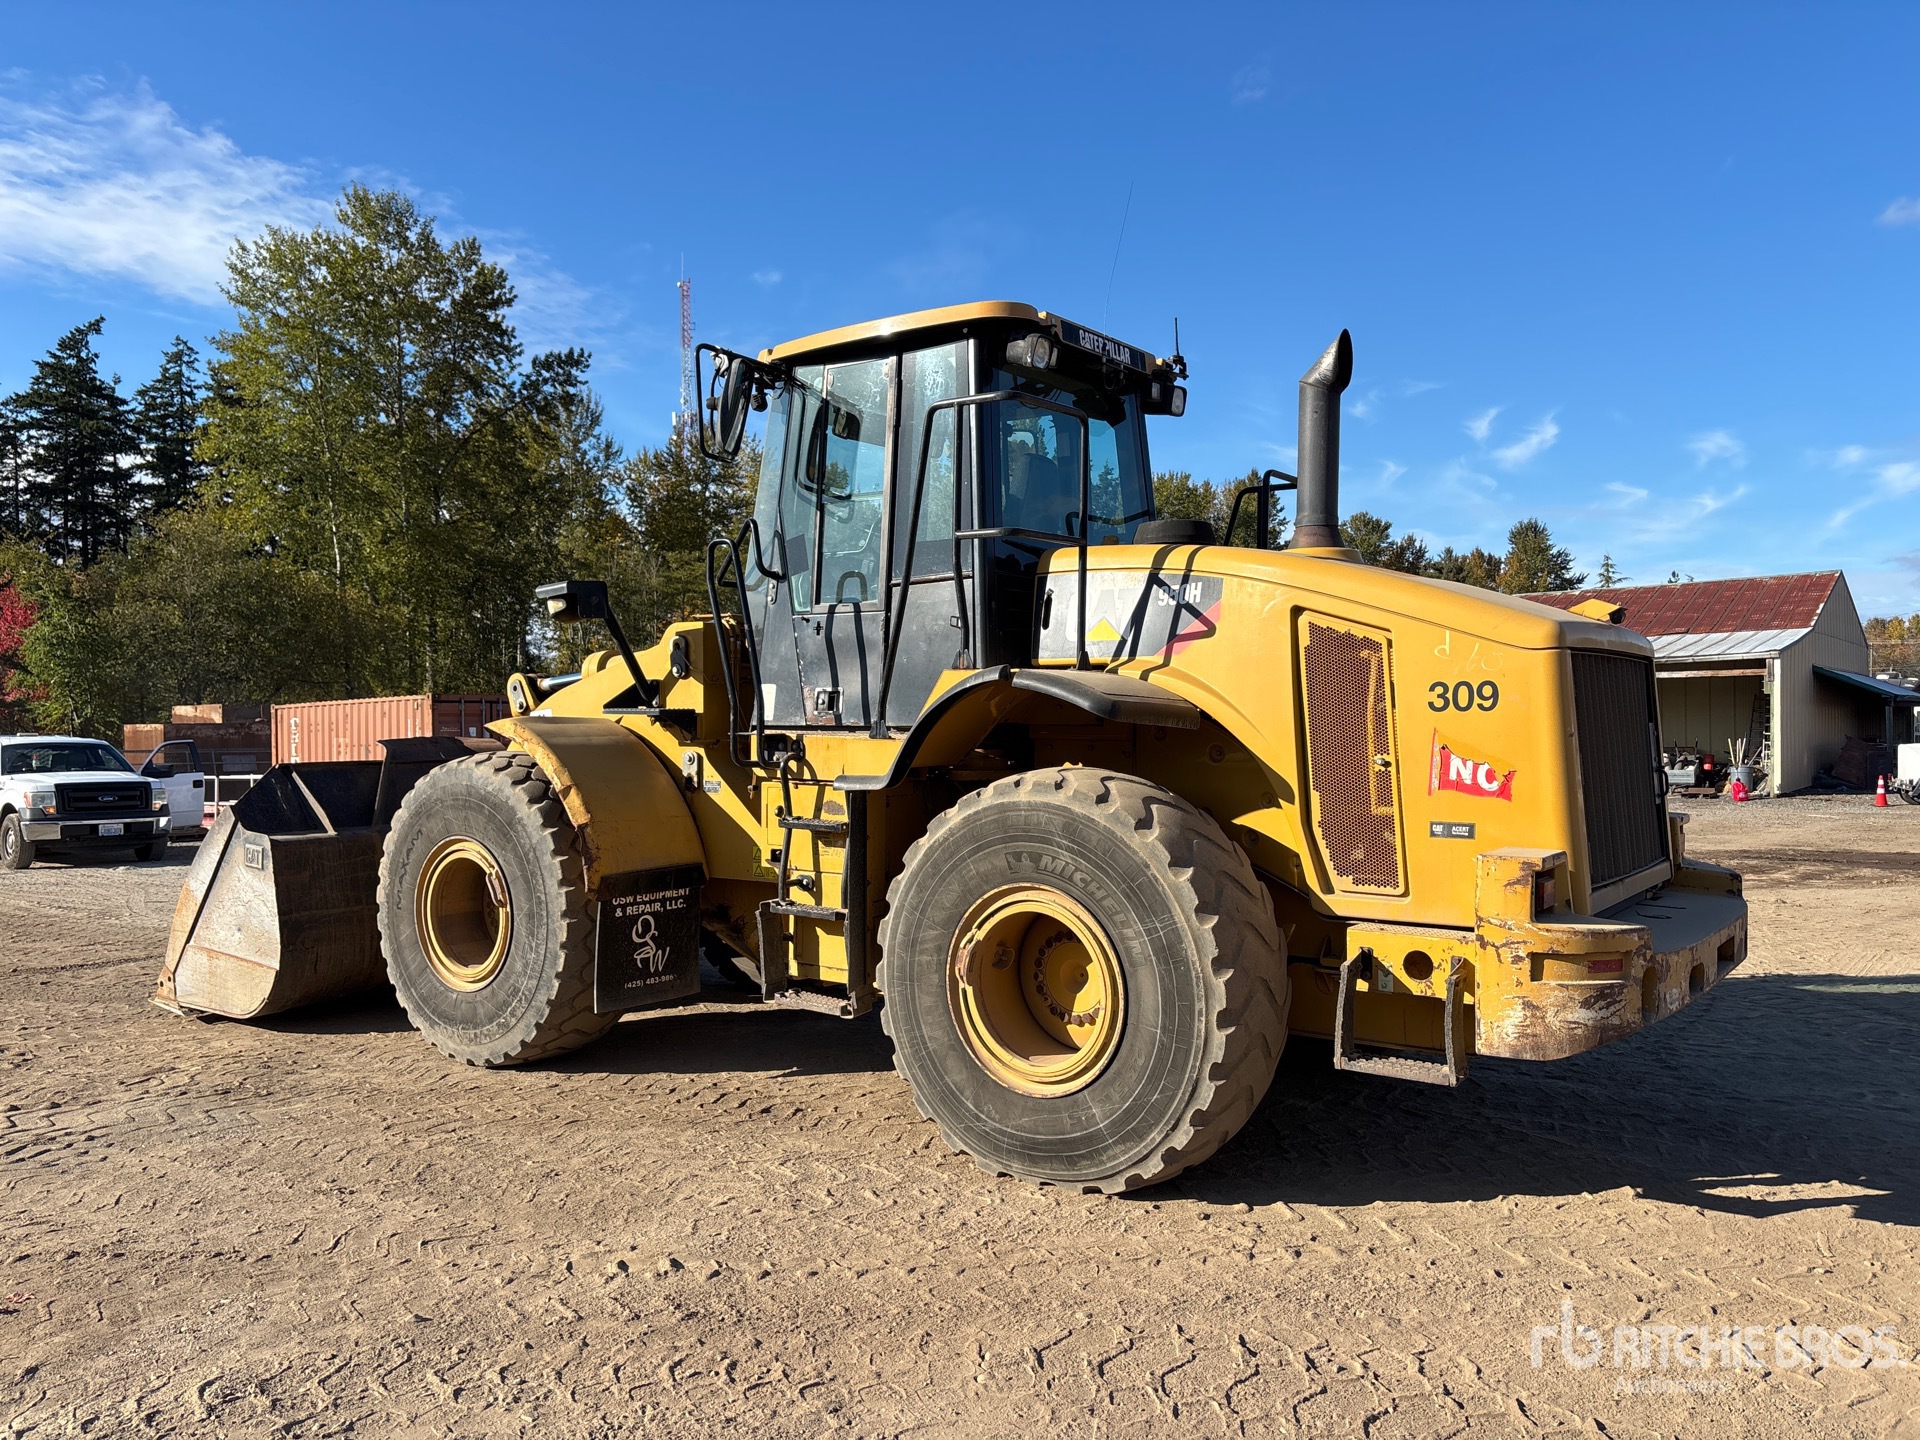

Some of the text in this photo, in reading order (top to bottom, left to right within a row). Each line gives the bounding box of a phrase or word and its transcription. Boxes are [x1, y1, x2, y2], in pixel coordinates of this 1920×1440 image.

[1158, 582, 1203, 607] 950H
[1427, 680, 1500, 712] 309
[246, 847, 261, 866] CAT
[396, 828, 424, 911] MAXAM
[615, 898, 687, 917] & REPAIR, LLC.
[1038, 854, 1147, 968] MICHELIN
[624, 979, 644, 990] (425)
